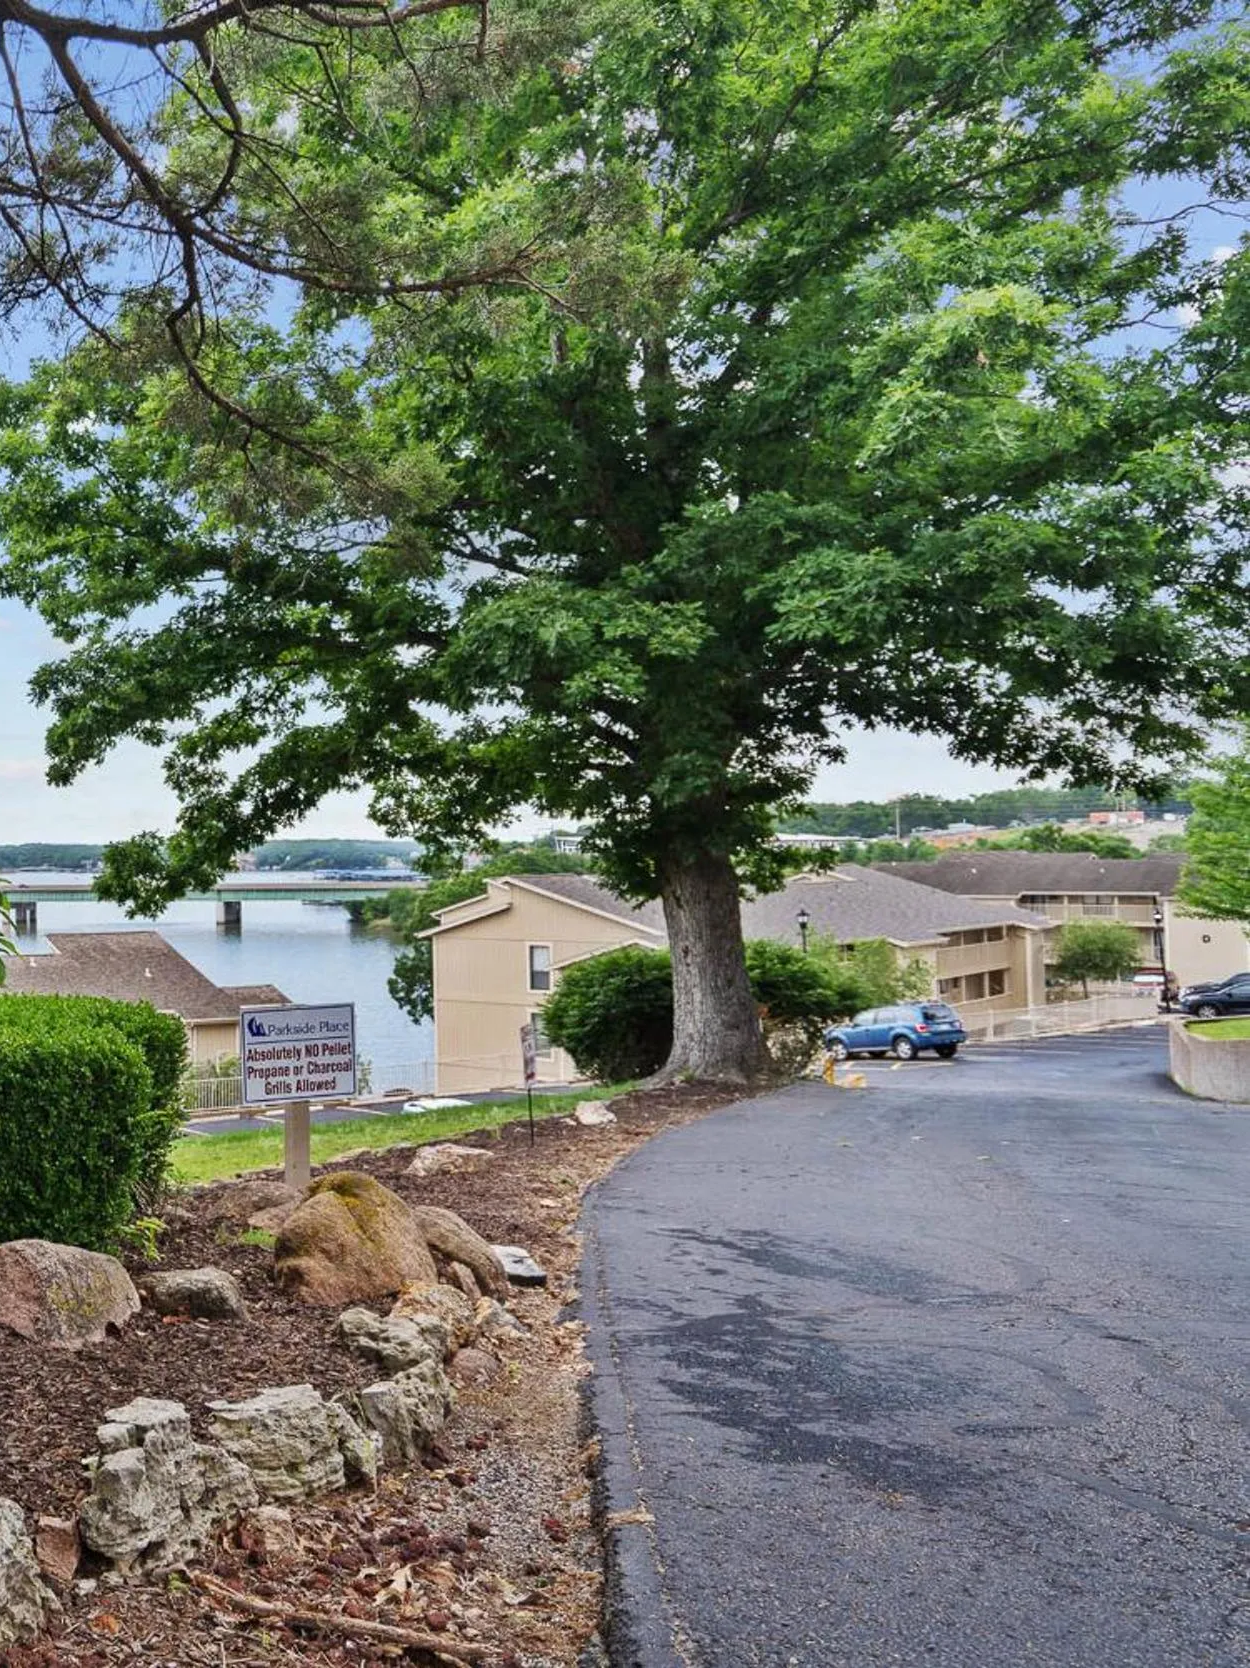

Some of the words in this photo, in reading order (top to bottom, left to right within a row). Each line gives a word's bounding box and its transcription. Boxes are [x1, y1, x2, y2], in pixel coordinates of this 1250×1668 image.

[268, 1023, 316, 1036] Parkside
[319, 1020, 350, 1033] Place
[247, 1045, 302, 1062] Absolutely
[304, 1044, 319, 1058] NO
[322, 1042, 351, 1056] Pellet
[247, 1065, 291, 1080] Propane
[293, 1065, 304, 1076] or
[307, 1059, 352, 1075] Charcoal
[264, 1081, 293, 1096] Grills
[295, 1077, 337, 1093] Allowed
